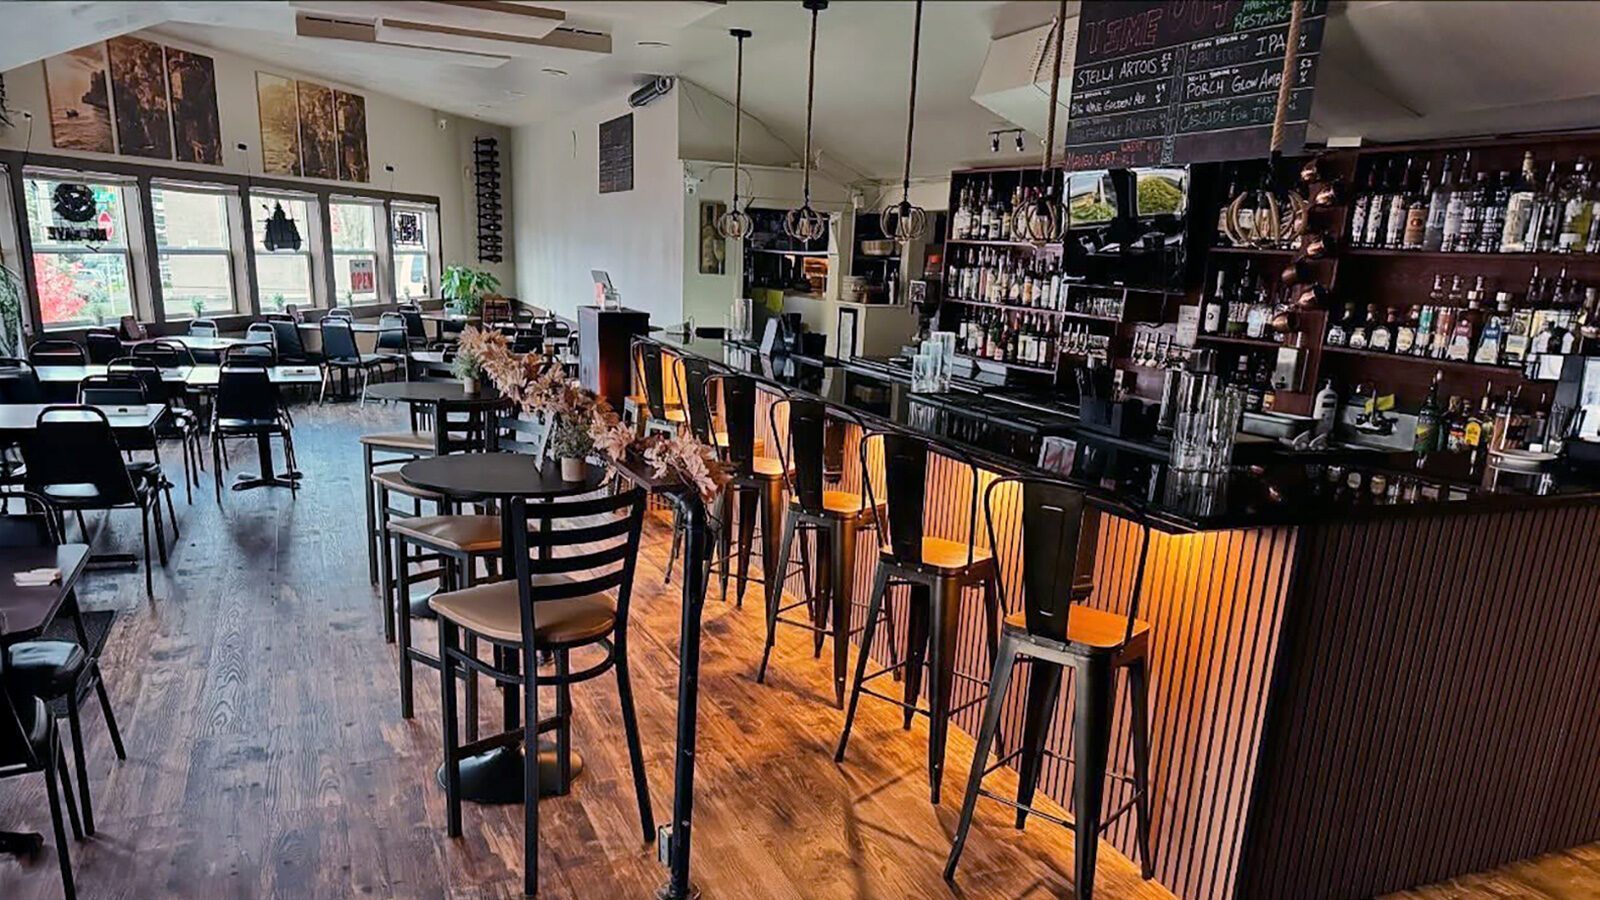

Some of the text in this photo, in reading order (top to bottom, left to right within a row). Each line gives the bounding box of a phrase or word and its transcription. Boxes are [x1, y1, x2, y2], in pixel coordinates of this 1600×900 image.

[1254, 33, 1287, 57] IPA
[1077, 66, 1114, 88] STELLA
[1118, 57, 1158, 80] ARTOIS
[1186, 79, 1225, 100] PORCH
[1258, 69, 1283, 90] AMB
[351, 272, 373, 291] OPEN
